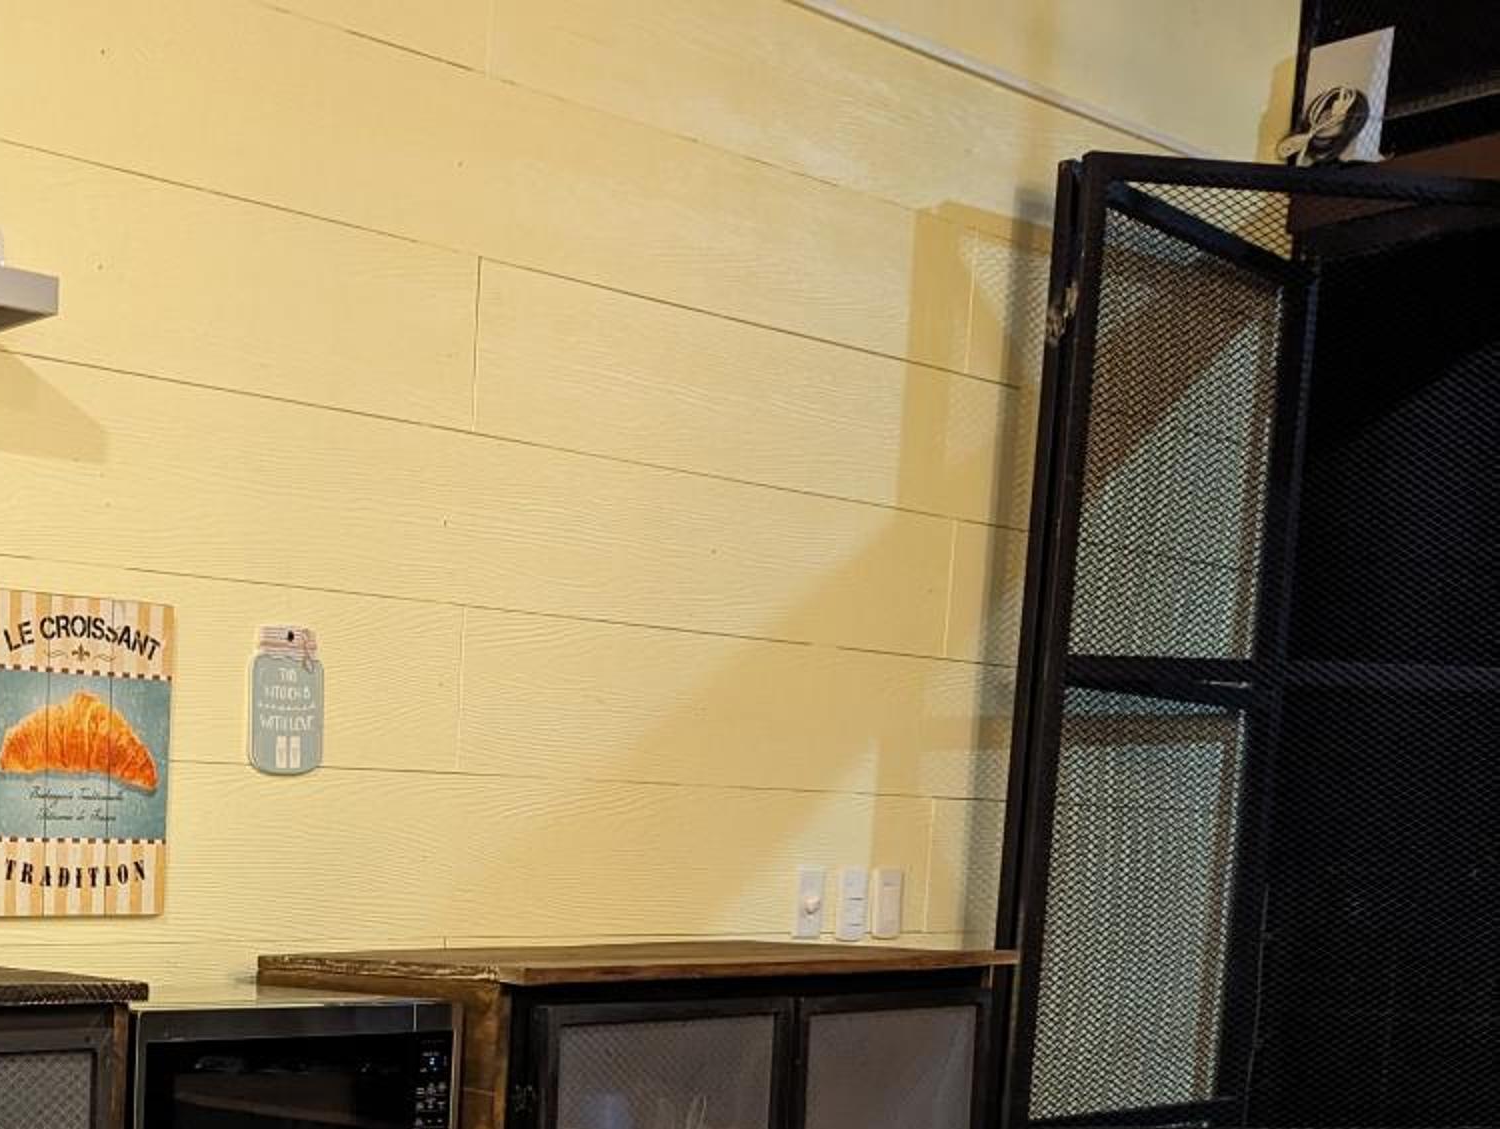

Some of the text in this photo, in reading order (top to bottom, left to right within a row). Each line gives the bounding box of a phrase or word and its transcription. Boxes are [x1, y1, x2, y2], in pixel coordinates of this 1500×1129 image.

[3, 615, 161, 661] LE CROISSANT
[5, 858, 146, 888] TRADITION
